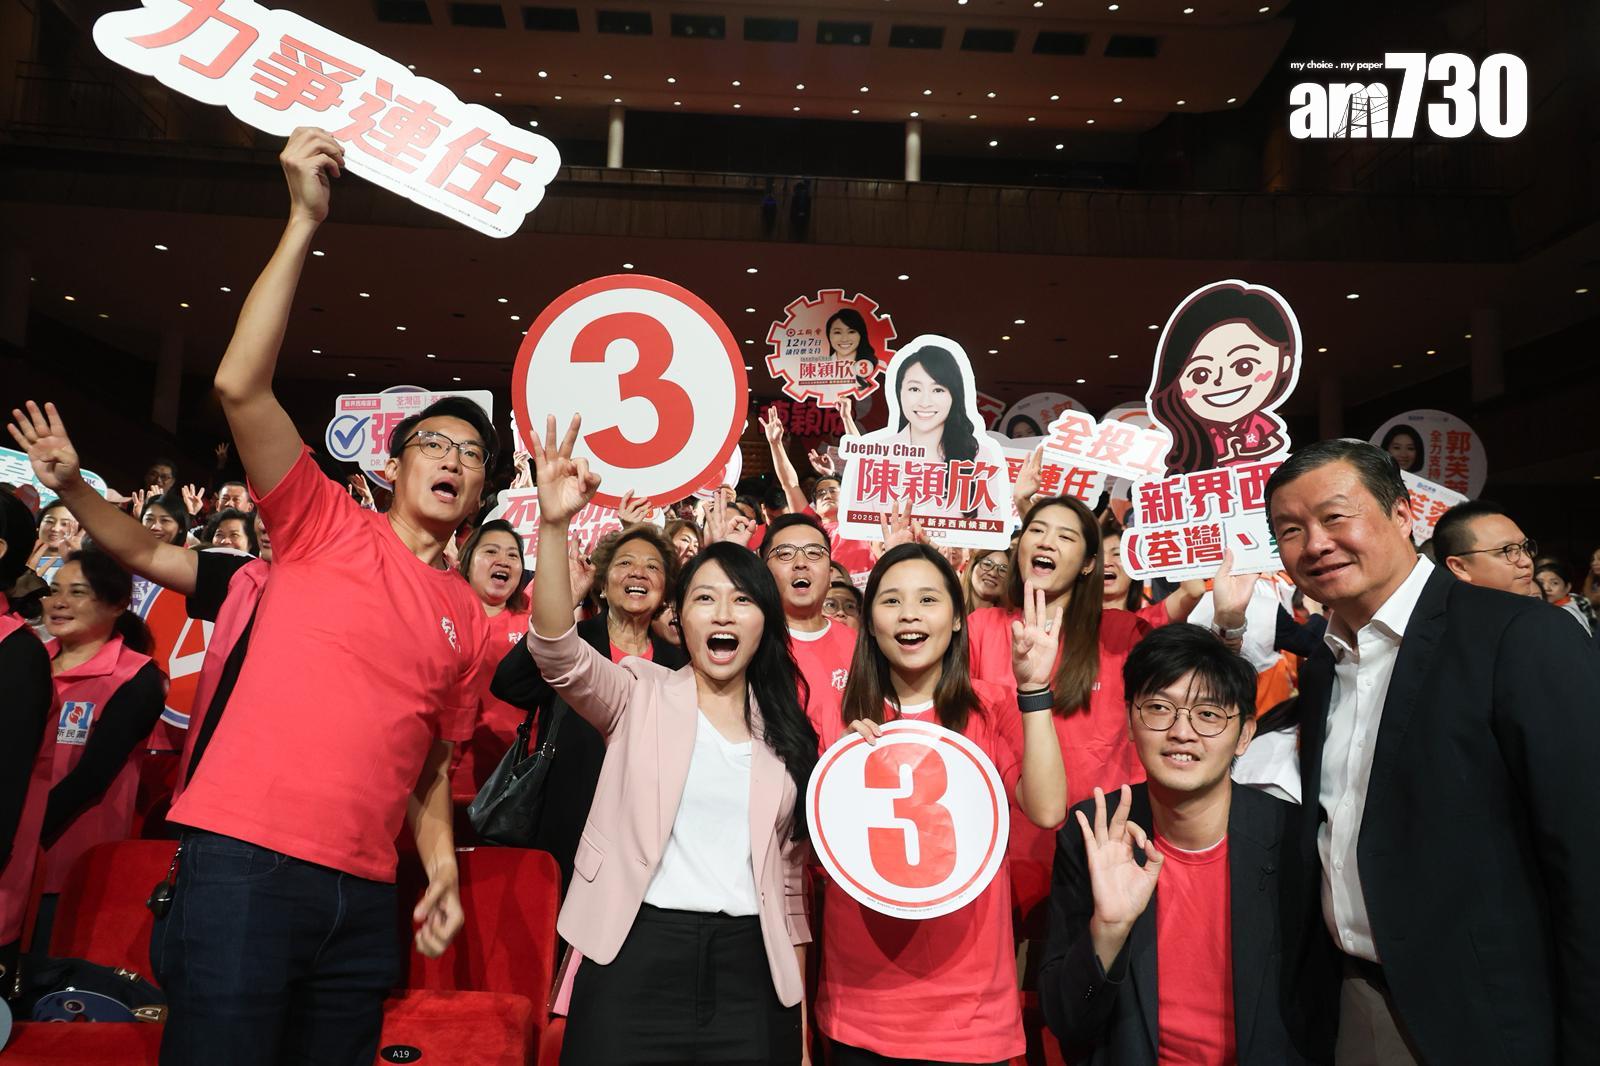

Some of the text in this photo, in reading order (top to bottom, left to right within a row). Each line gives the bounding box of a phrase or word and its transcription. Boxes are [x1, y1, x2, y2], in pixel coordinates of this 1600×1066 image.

[126, 0, 538, 216] 力爭連任
[800, 360, 856, 379] 陳穎欣
[859, 361, 869, 375] 3
[570, 311, 695, 469] 3
[845, 441, 926, 458] Joephy Chan
[856, 457, 1000, 512] 陳穎欣
[864, 742, 957, 888] 3
[392, 1050, 410, 1058] A19
